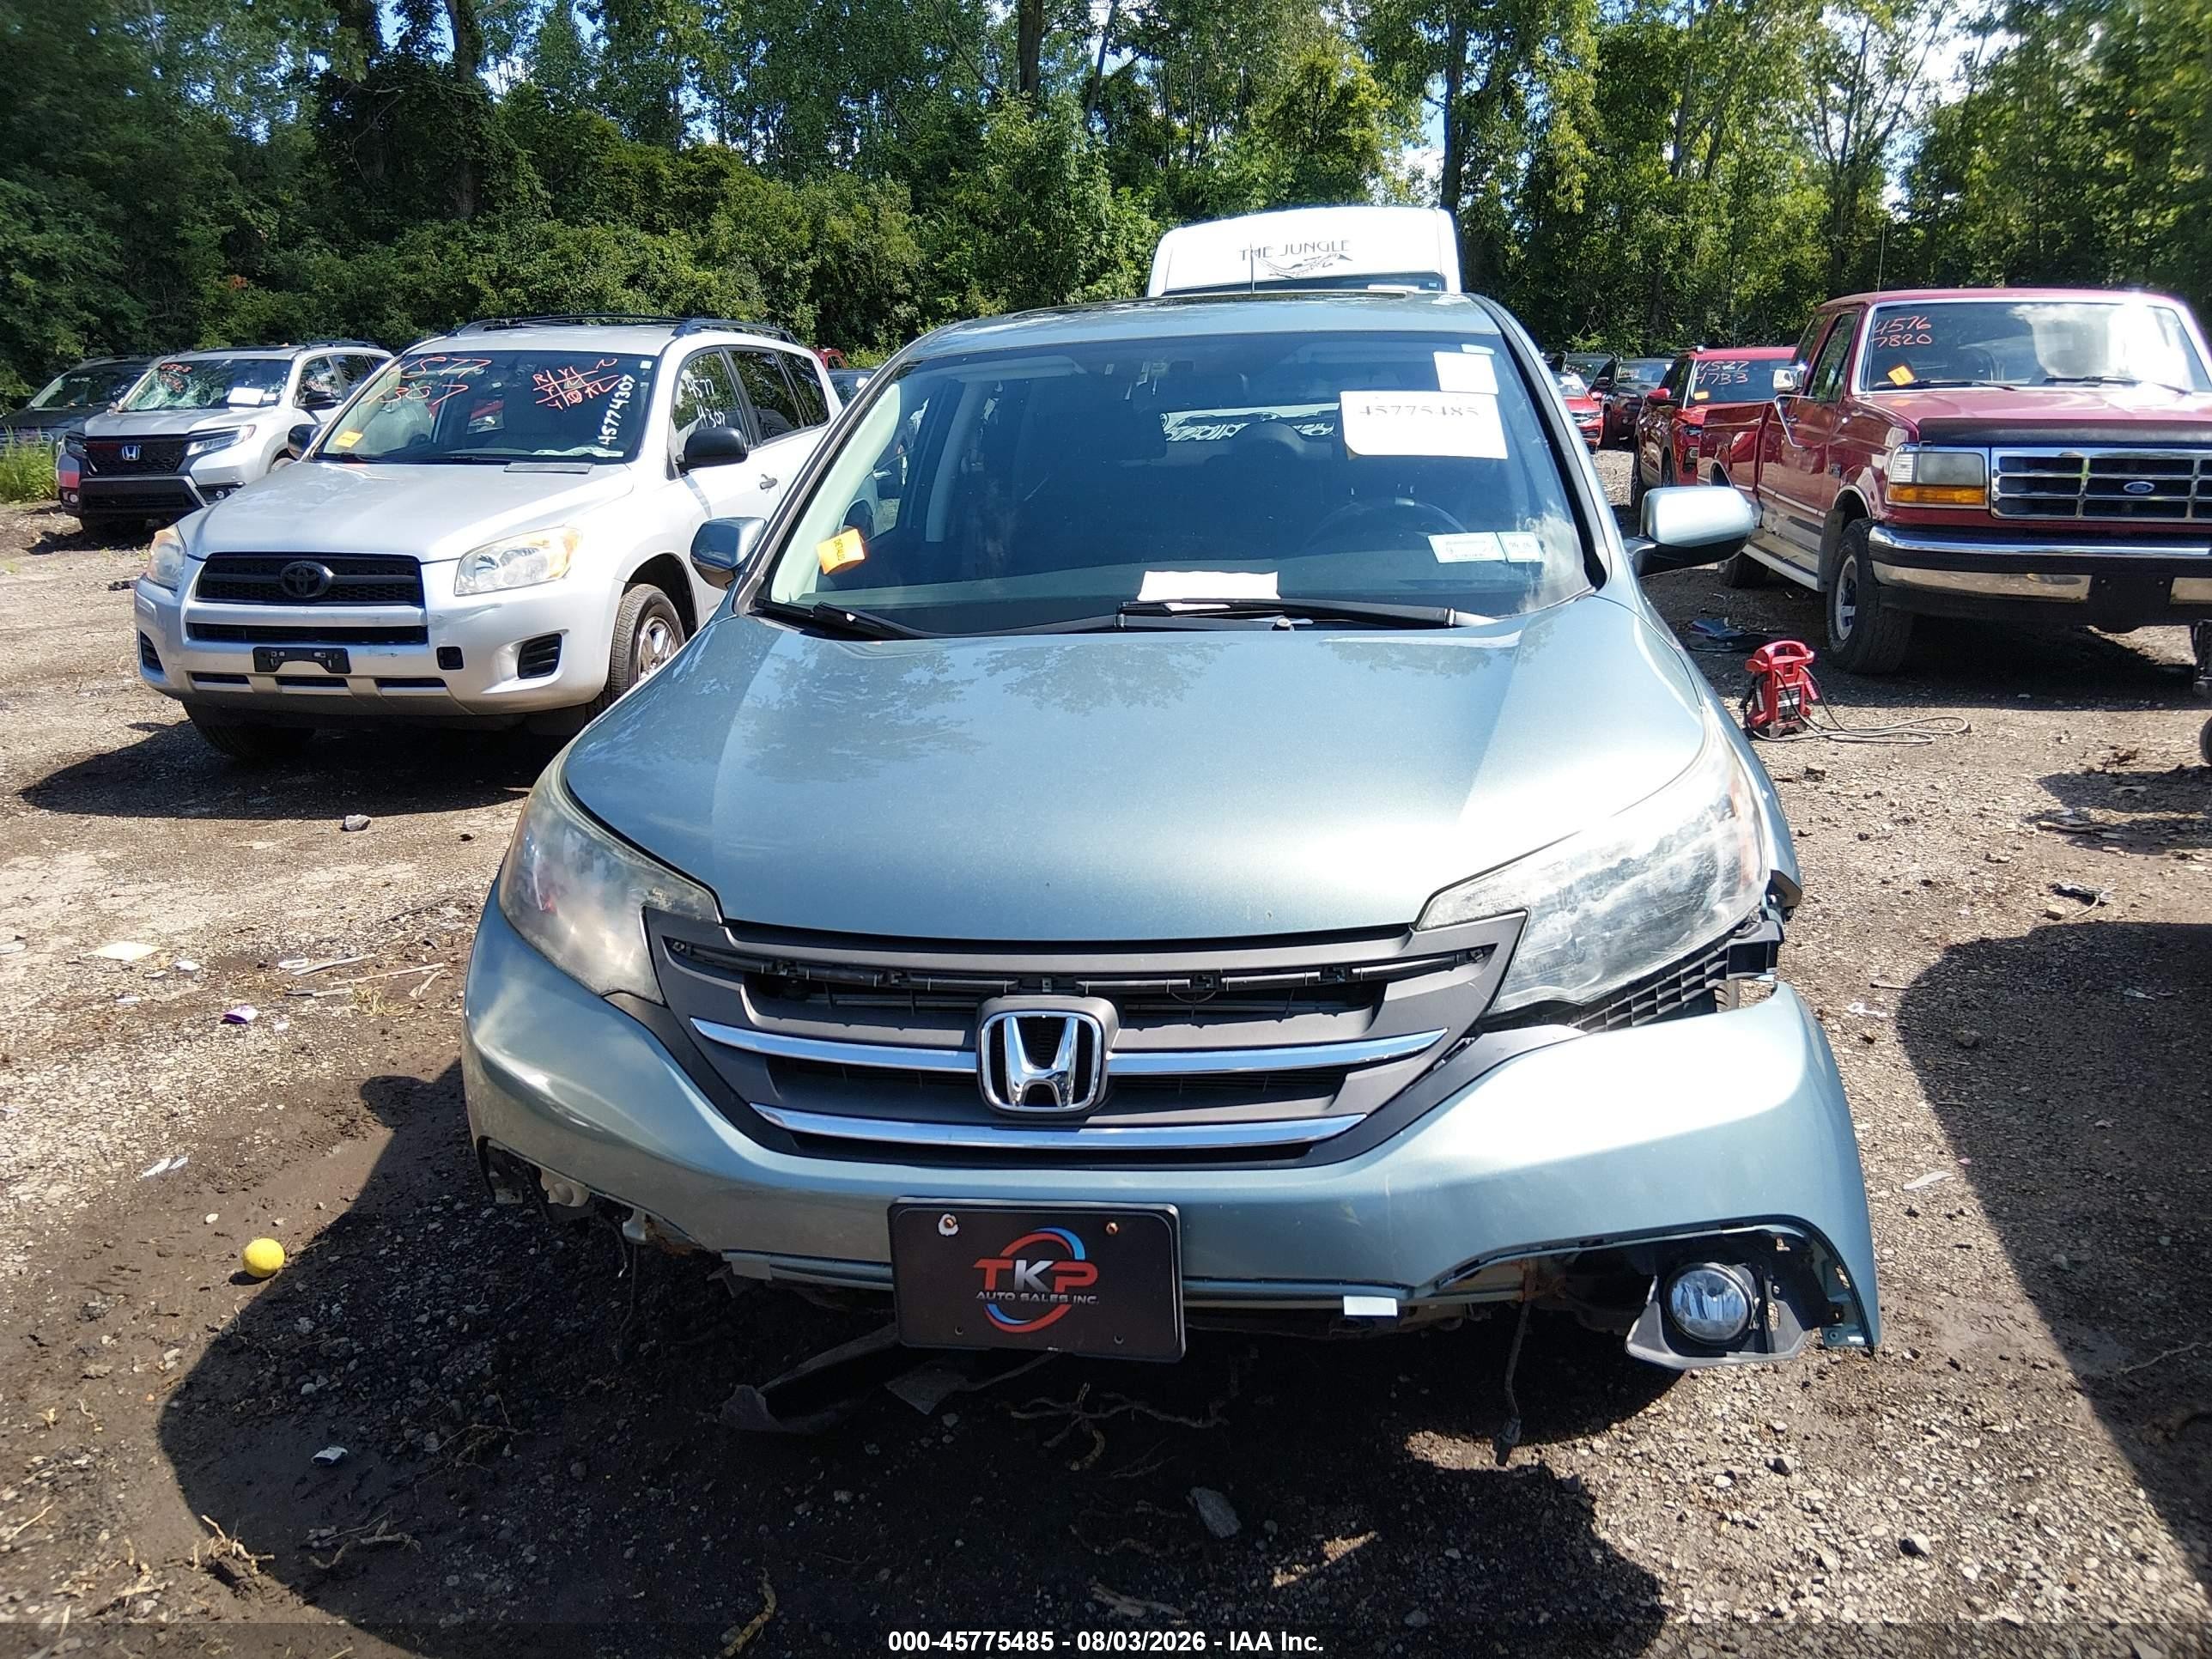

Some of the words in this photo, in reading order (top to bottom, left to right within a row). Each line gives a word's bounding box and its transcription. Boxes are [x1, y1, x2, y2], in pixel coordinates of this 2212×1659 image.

[1239, 246, 1273, 261] THE
[1279, 240, 1351, 257] JUNGLE
[1874, 315, 1932, 335] 4576
[1871, 333, 1932, 348] 7820
[597, 374, 635, 446] 45774307
[974, 1258, 1099, 1293] TKP
[975, 1291, 1017, 1302] AUTO
[1019, 1292, 1069, 1304] SALES
